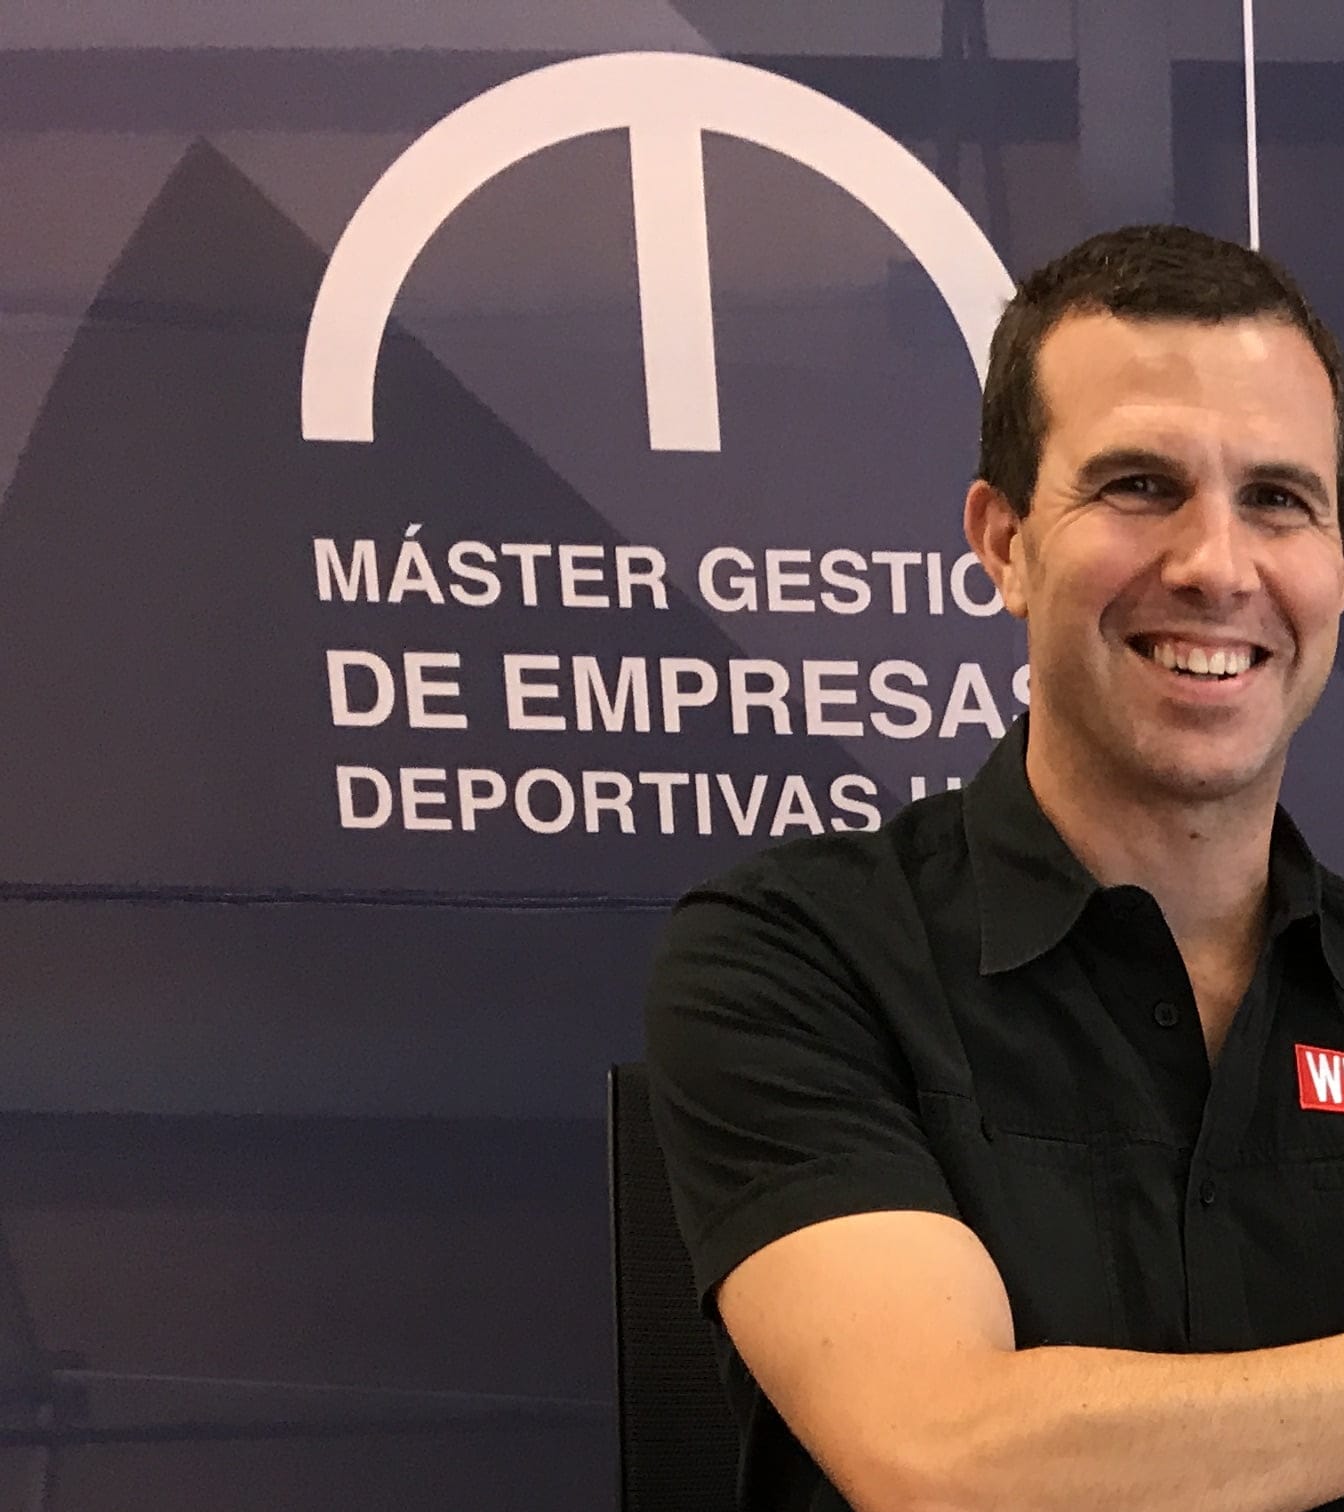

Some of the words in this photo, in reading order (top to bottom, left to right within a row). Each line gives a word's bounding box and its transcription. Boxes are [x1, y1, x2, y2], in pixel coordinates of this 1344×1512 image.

[313, 523, 669, 611] MÁSTER
[327, 650, 468, 731] DE
[337, 765, 881, 835] DEPORTIVAS
